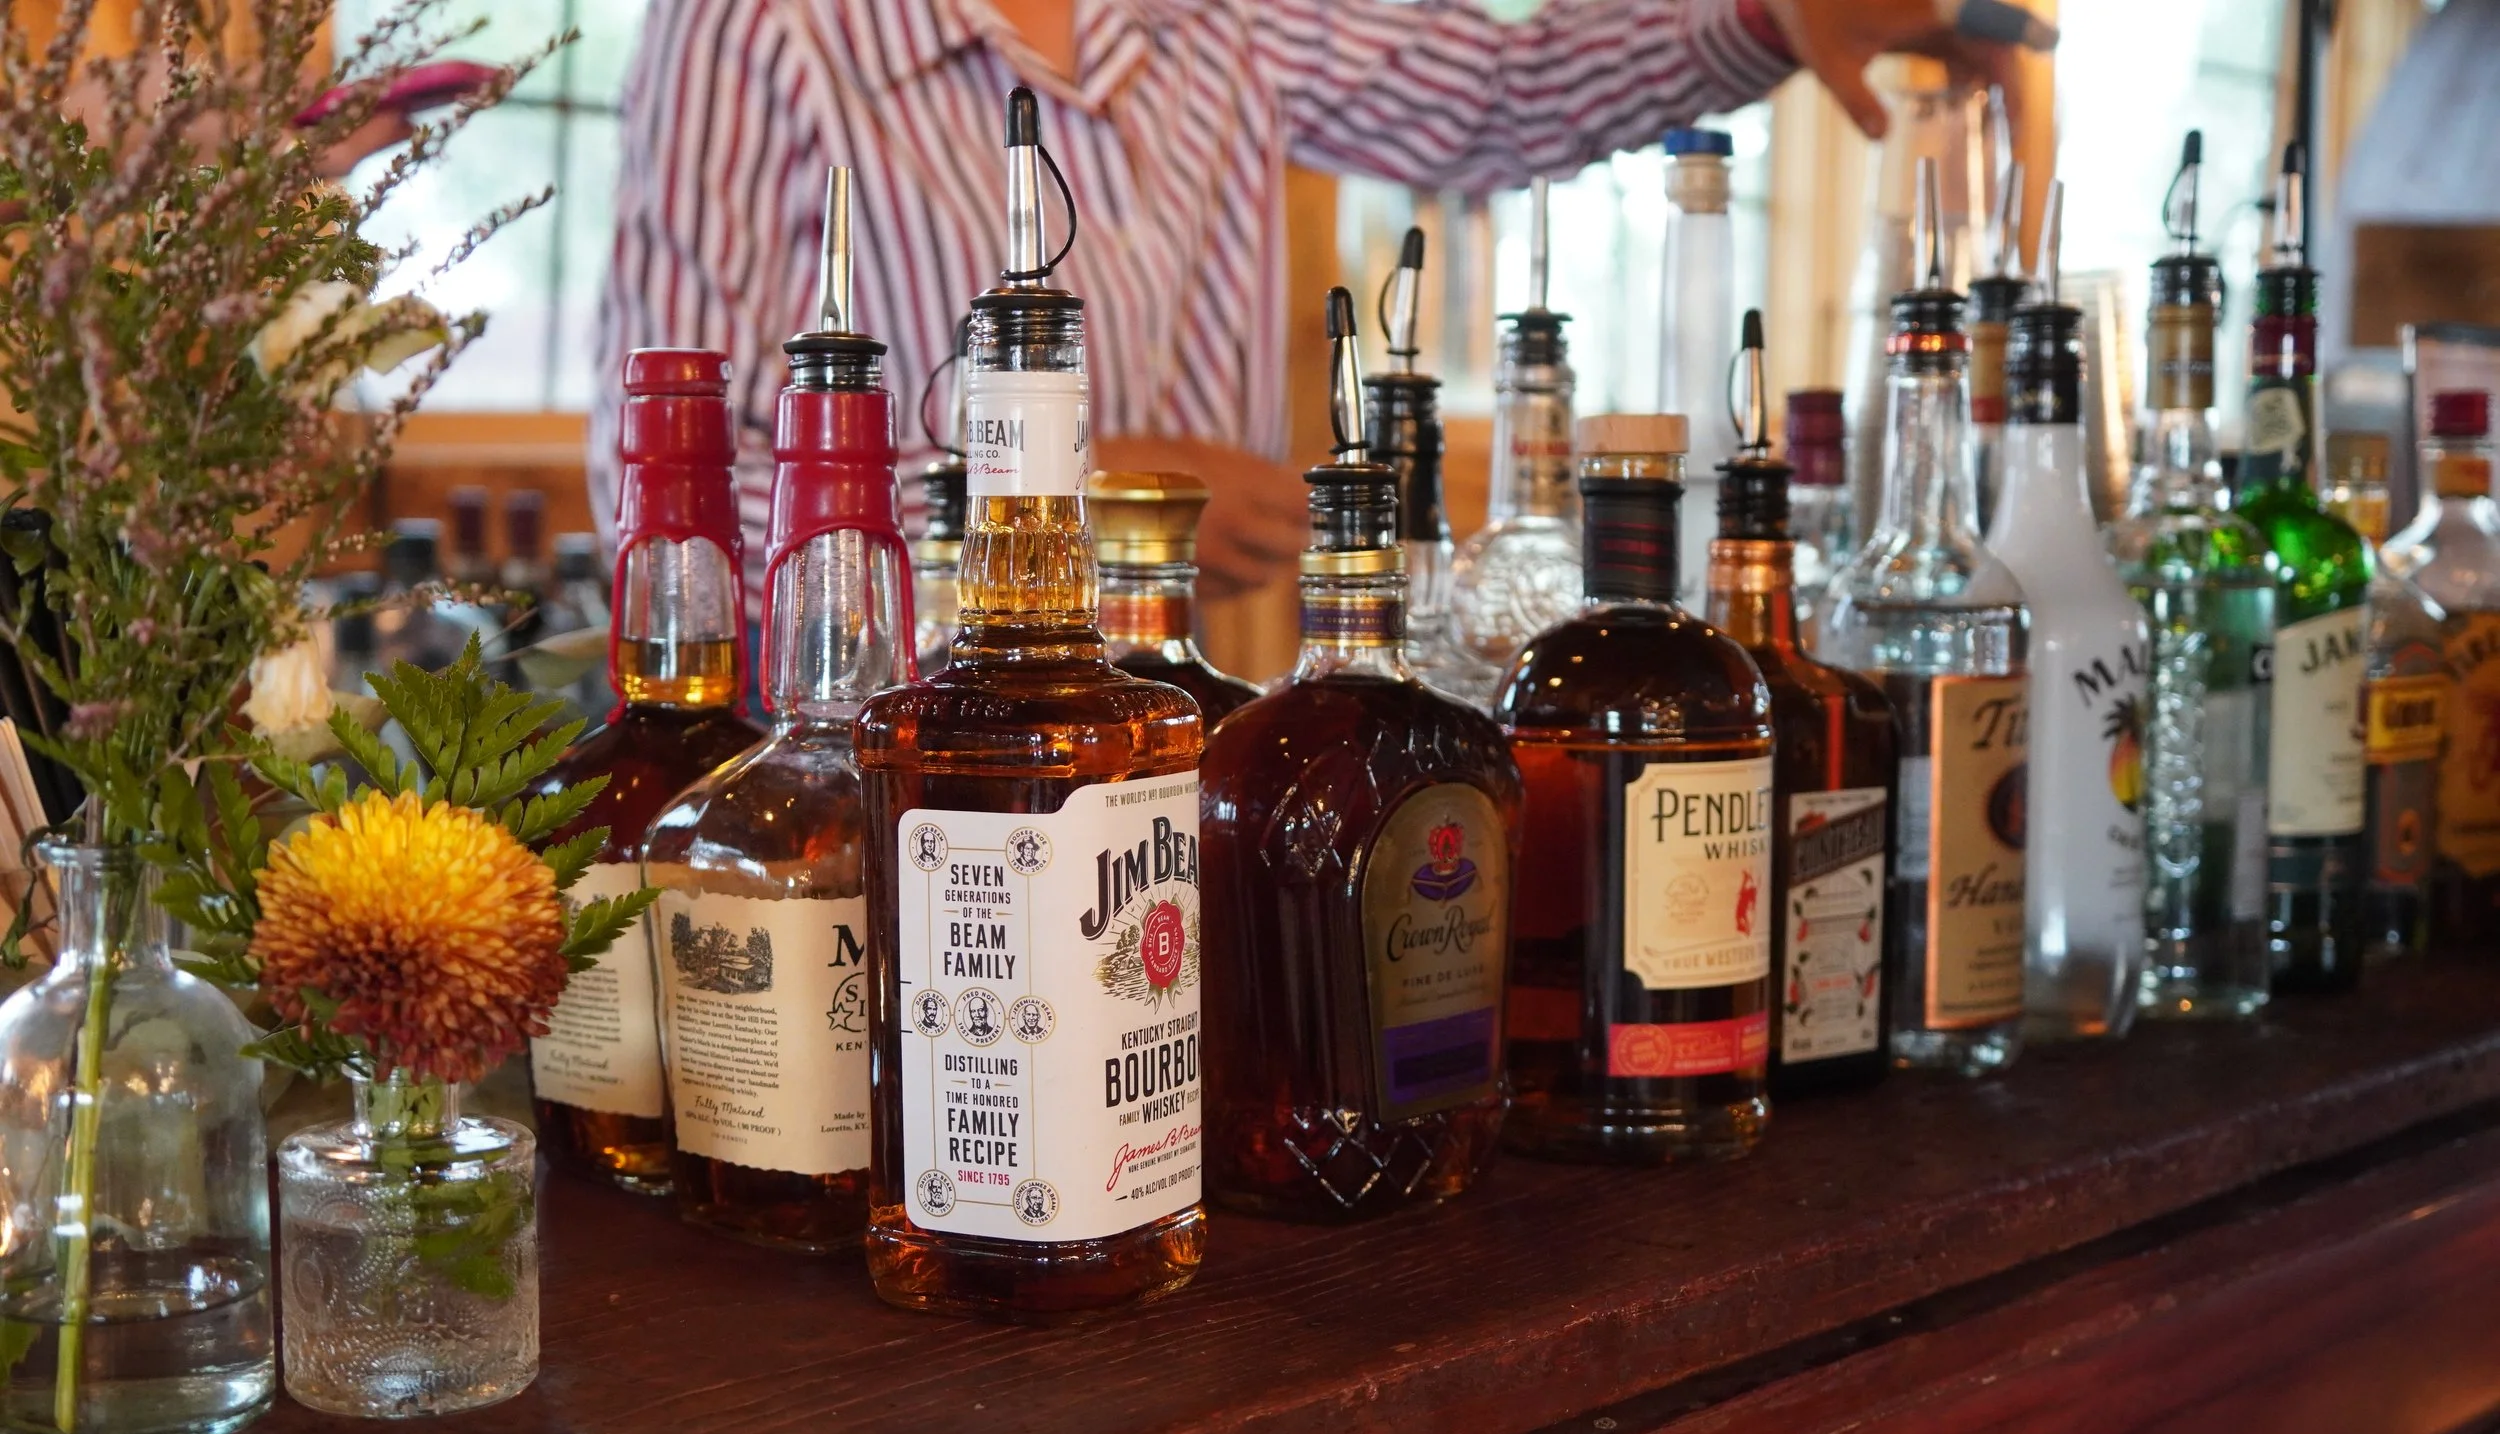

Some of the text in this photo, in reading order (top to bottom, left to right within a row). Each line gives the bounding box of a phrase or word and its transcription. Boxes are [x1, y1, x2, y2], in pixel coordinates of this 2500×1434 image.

[1074, 420, 1087, 452] JA
[986, 449, 1000, 459] CO.
[1105, 794, 1118, 808] THE
[1120, 790, 1147, 806] WORLD'S
[913, 826, 944, 842] JACOB BEAM
[1010, 829, 1047, 846] BOOKER NOE
[950, 863, 1004, 887] SEVEN
[1031, 859, 1047, 873] 2004
[1079, 816, 1200, 941] JIM BEA
[944, 889, 1011, 905] GENERATIONS
[962, 907, 992, 919] OF THE
[950, 922, 1006, 950] BEAM
[1158, 931, 1170, 956] B
[1386, 912, 1444, 962] Crown
[943, 951, 1016, 980] FAMILY
[916, 992, 946, 1008] DAVID BEAM
[962, 990, 996, 1003] FRED NOE
[734, 1004, 778, 1016] neighborhood,
[1013, 998, 1053, 1021] JEREMIAH BEAM
[734, 1013, 746, 1021] Star
[748, 1015, 760, 1023] Hill
[760, 1017, 778, 1025] Farm
[734, 1024, 763, 1036] Kentucky.
[958, 1022, 1001, 1044] 1957 PRESENT
[1121, 1010, 1198, 1051] KENTUCKY STRAIGHT
[734, 1034, 767, 1046] homeplace
[770, 1039, 778, 1047] of
[836, 1041, 867, 1052] KEN
[720, 1043, 749, 1054] designated
[749, 1047, 778, 1059] Kentucky
[713, 1062, 735, 1072] discover
[750, 1068, 767, 1076] about
[732, 1055, 763, 1067] Landmark.
[763, 1060, 779, 1068] We'd
[944, 1054, 1018, 1076] DISTILLING
[1105, 1031, 1200, 1109] BOURBO
[712, 1083, 735, 1095] crafting
[736, 1087, 759, 1098] whisky.
[748, 1078, 780, 1089] handmade
[971, 1077, 991, 1090] TO A
[693, 1094, 766, 1119] Fully Matured
[946, 1091, 1019, 1109] TIME HONORED
[1119, 1109, 1140, 1127] FAMILY
[1142, 1089, 1186, 1124] WHISKEY
[834, 1112, 866, 1121] Made by
[947, 1107, 1019, 1138] FAMILY
[949, 1137, 1018, 1168] RECIPE
[1106, 1140, 1164, 1192] James
[1128, 1164, 1139, 1174] NONE
[1140, 1157, 1157, 1171] GENUINE
[1157, 1150, 1174, 1164] WITHOUT
[919, 1173, 932, 1189] DAVID
[940, 1175, 953, 1192] BEAM
[957, 1169, 1010, 1186] SINCE 1795
[1015, 1184, 1027, 1210] COLONEL
[1028, 1181, 1047, 1190] JAMES
[1049, 1193, 1057, 1211] BEAM
[1130, 1185, 1144, 1200] 40%
[1145, 1177, 1167, 1196] ALC/VOL
